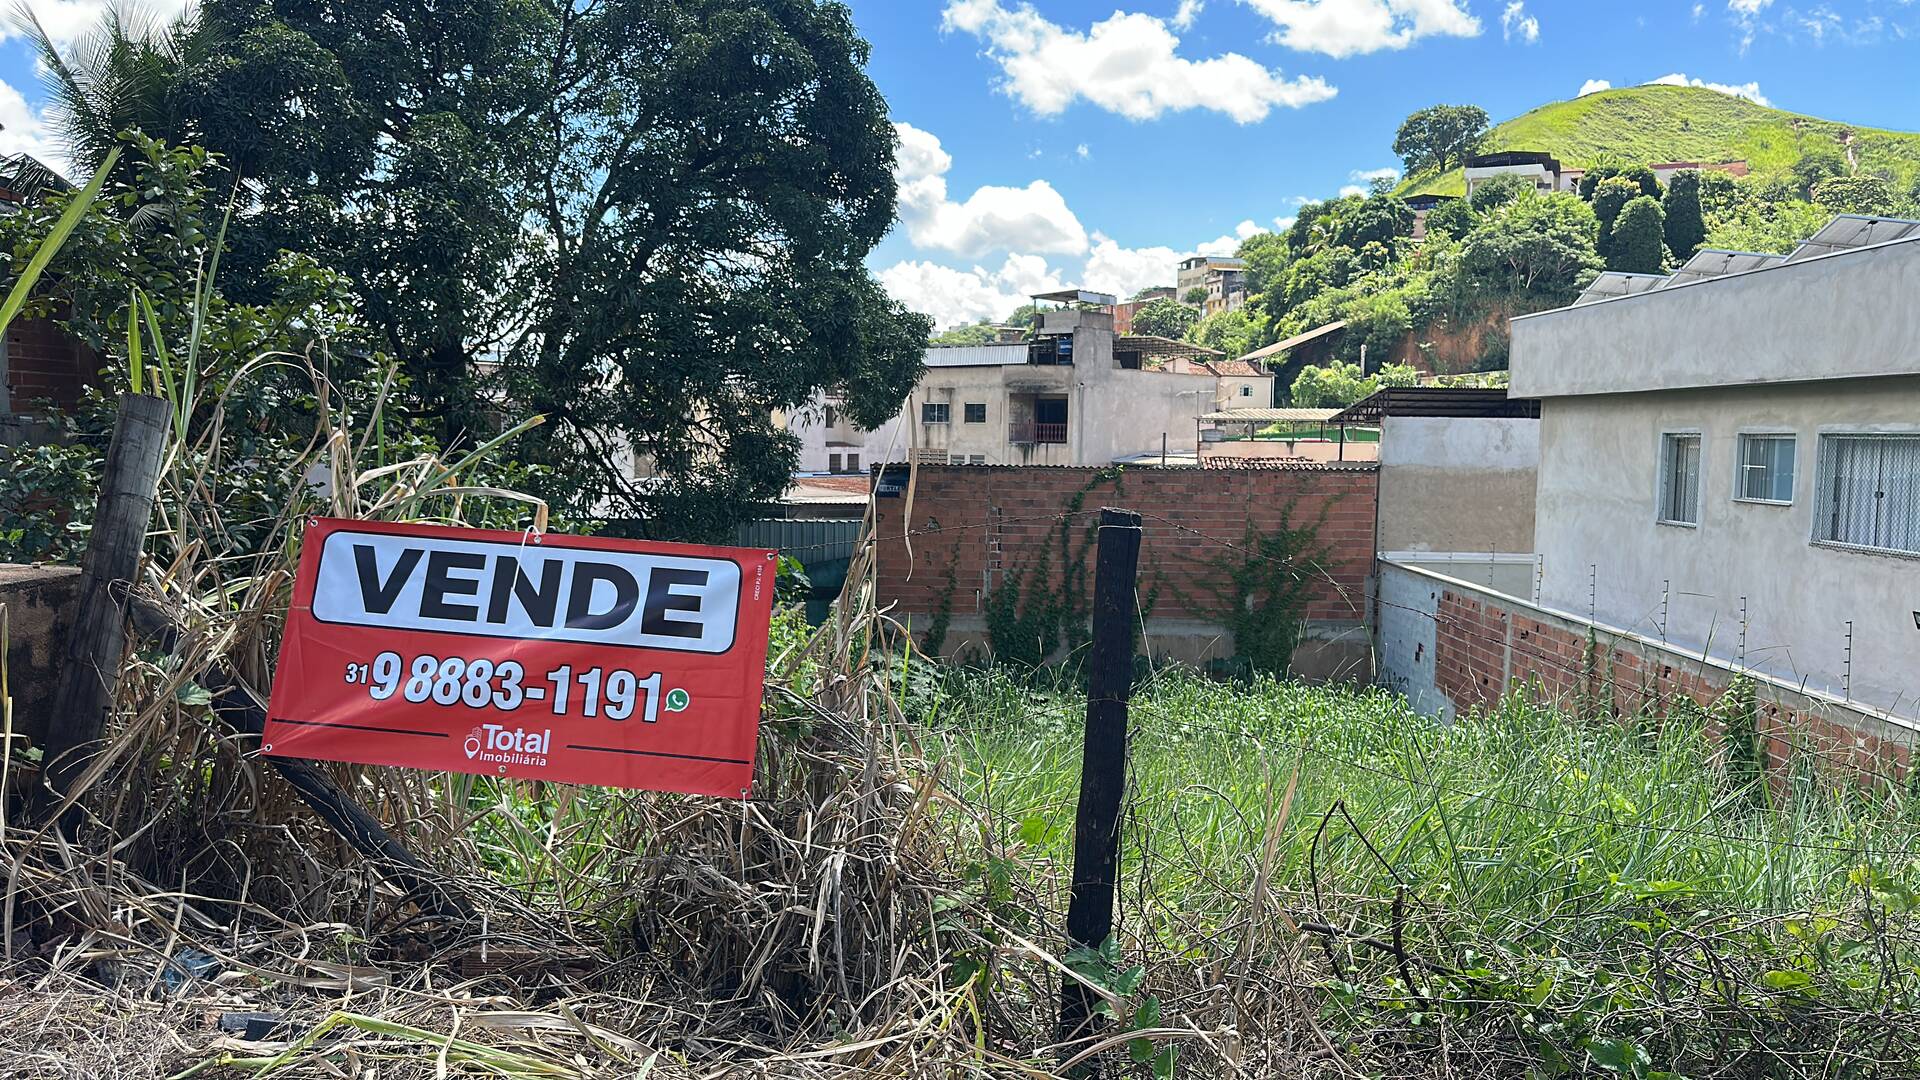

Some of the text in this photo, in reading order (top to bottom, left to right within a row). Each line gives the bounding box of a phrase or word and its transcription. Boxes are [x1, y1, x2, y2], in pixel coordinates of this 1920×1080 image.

[352, 544, 709, 639] VENDE
[345, 663, 369, 684] 31
[403, 653, 663, 723] 8883-1191
[480, 750, 547, 767] Imobiliária
[482, 723, 551, 754] Total
